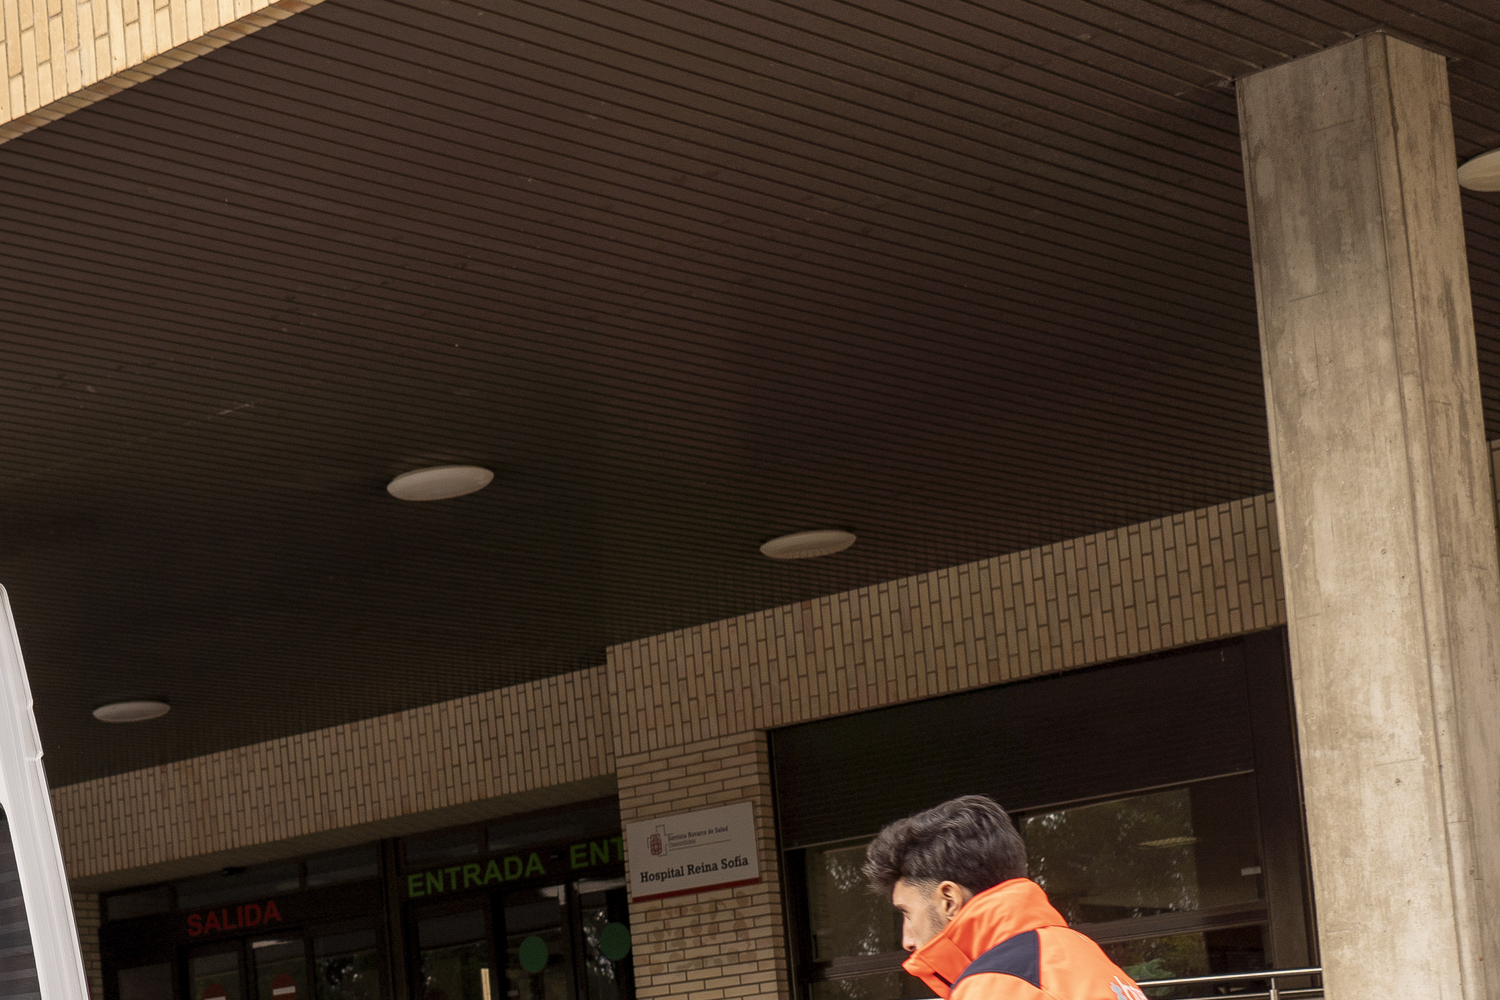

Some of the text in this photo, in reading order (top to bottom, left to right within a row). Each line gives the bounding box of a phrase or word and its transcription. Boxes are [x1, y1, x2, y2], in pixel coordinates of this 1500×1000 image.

[407, 852, 546, 898] ENTRADA
[640, 855, 749, 883] Hospital Reina Sofía
[187, 900, 282, 937] SALIDA
